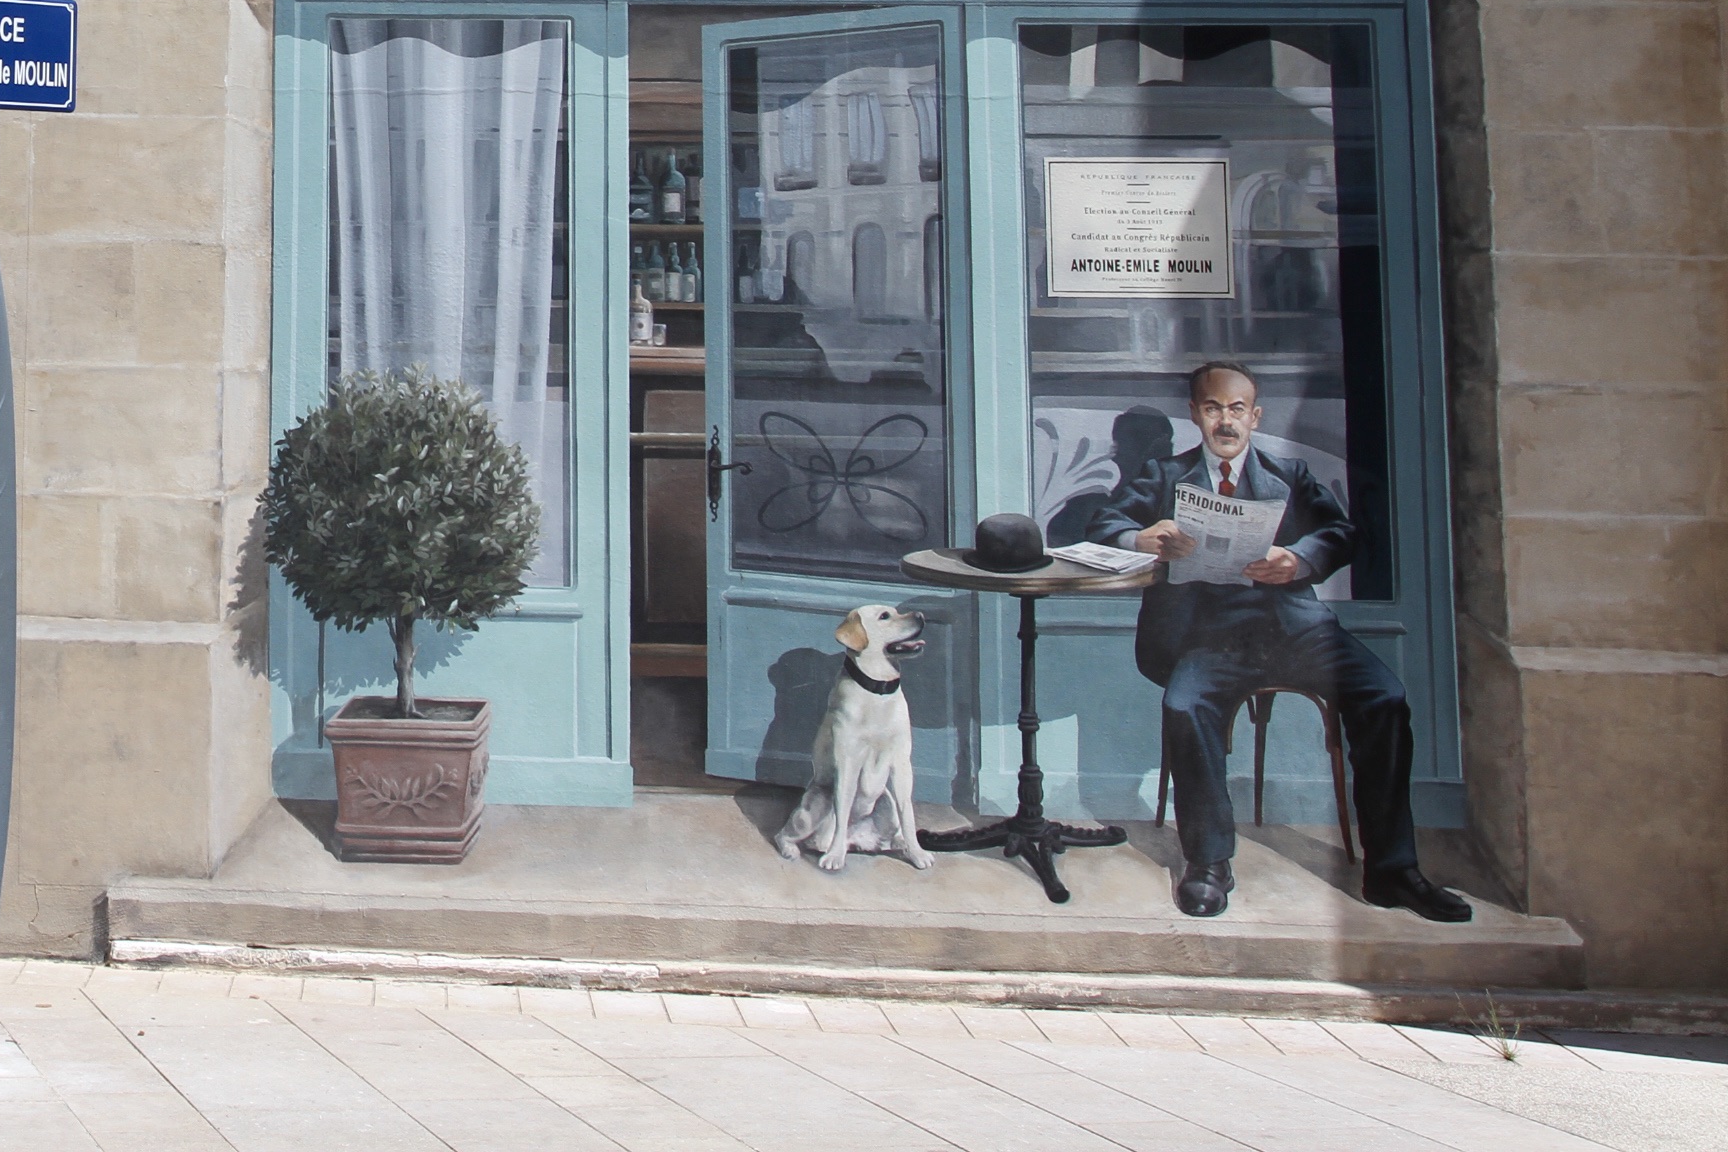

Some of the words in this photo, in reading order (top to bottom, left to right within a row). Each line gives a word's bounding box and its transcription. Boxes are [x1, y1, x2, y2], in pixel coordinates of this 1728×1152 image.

[14, 60, 68, 88] MOULIN
[1084, 207, 1117, 215] Election
[1132, 208, 1162, 216] Conseil
[1071, 233, 1109, 241] Candidat
[1124, 233, 1157, 243] Congrès
[1160, 233, 1210, 243] Républicain
[1071, 259, 1160, 273] ANTOINE-EMILE
[1168, 259, 1212, 274] MOULIN
